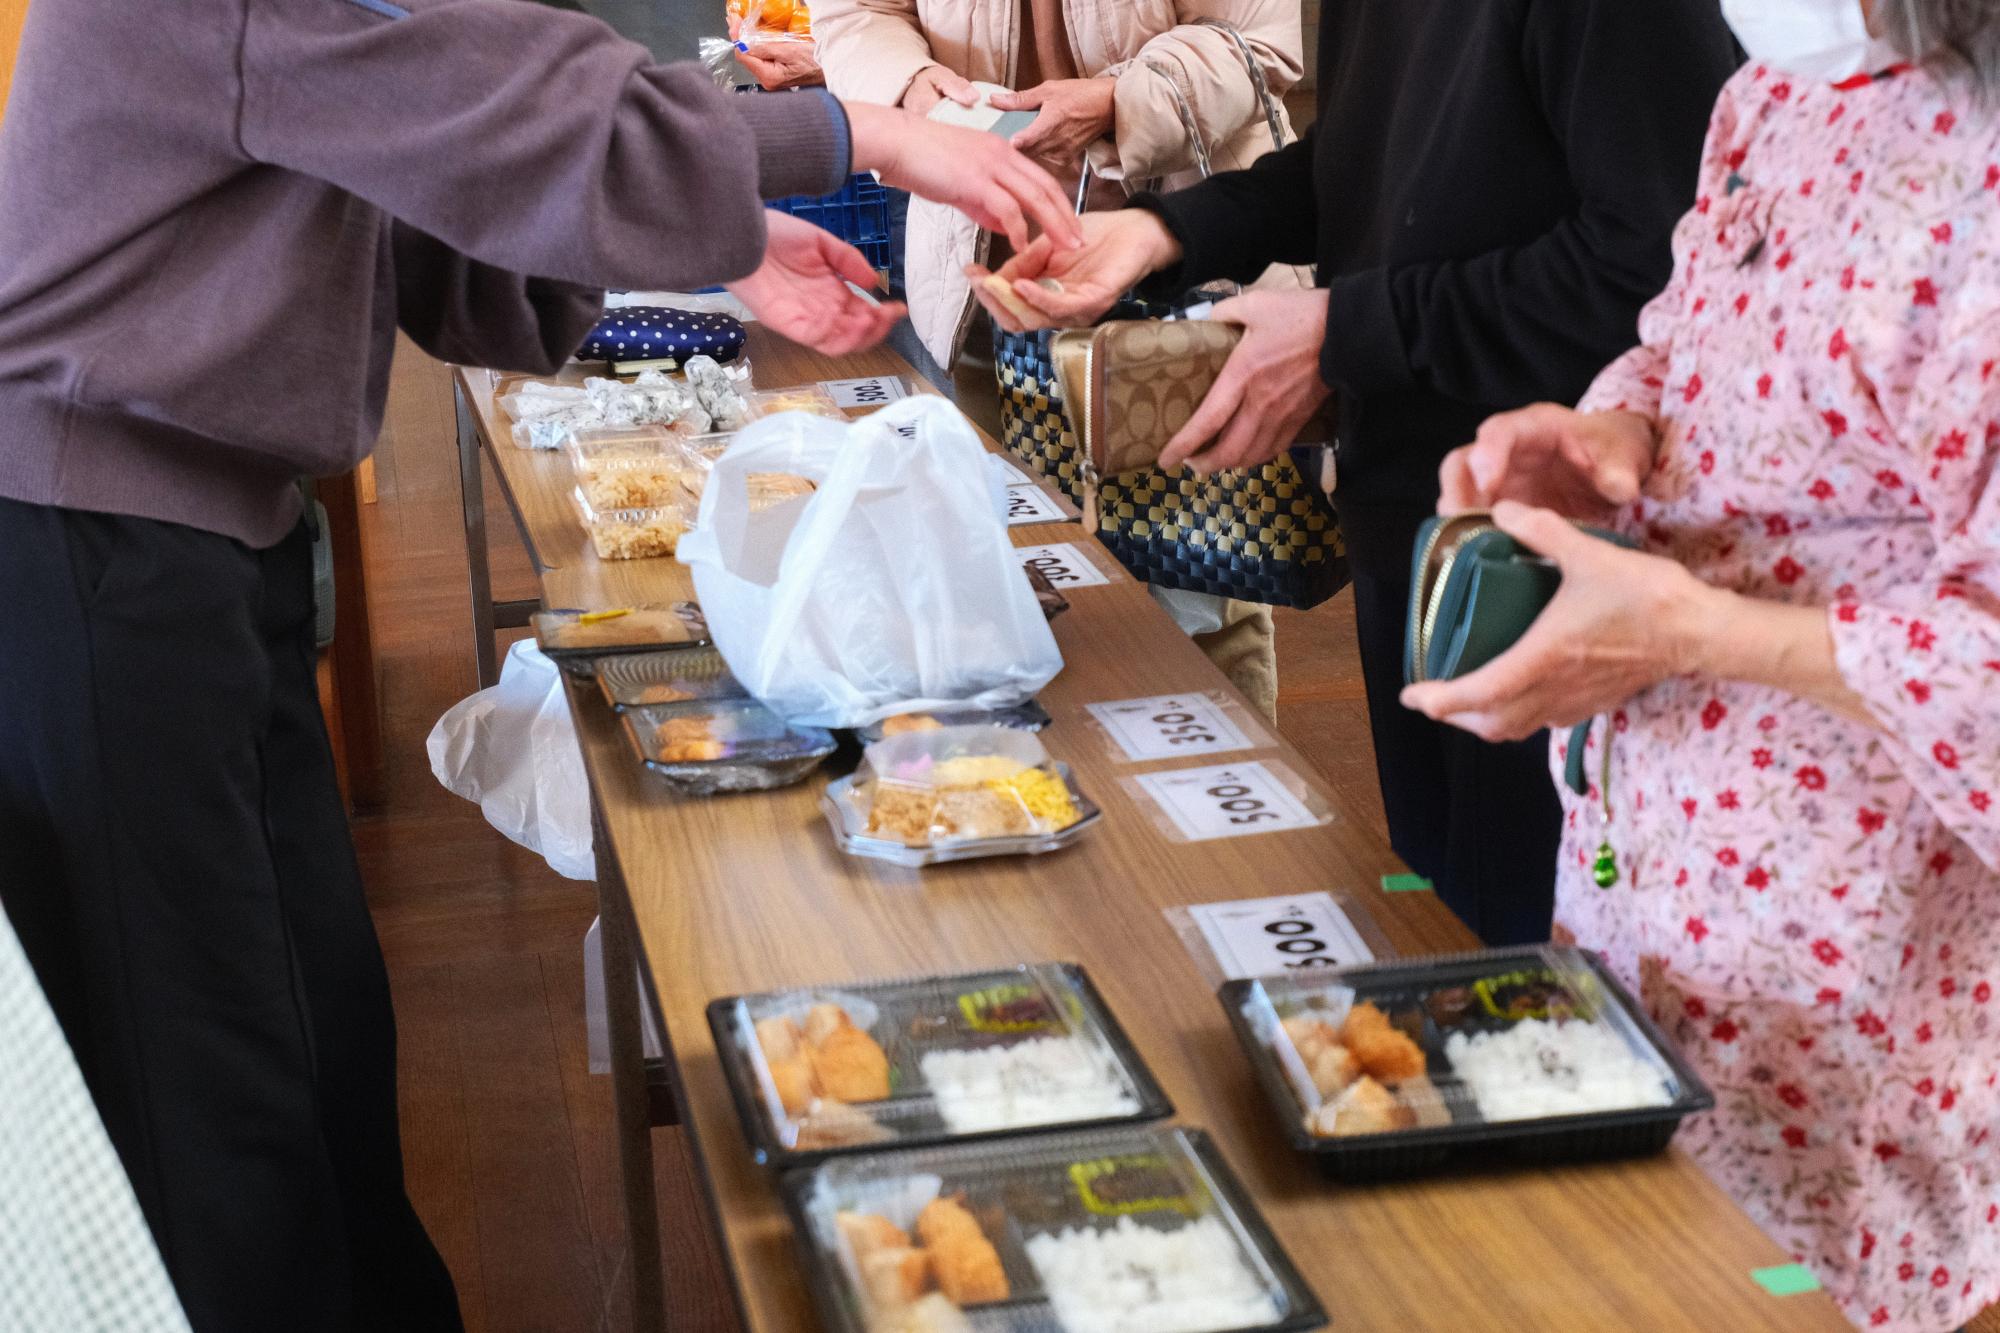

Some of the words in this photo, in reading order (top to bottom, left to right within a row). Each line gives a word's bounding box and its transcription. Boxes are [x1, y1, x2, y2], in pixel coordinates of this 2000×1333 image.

[853, 380, 889, 402] 500
[1152, 700, 1216, 745] 350
[1206, 771, 1280, 824] 500
